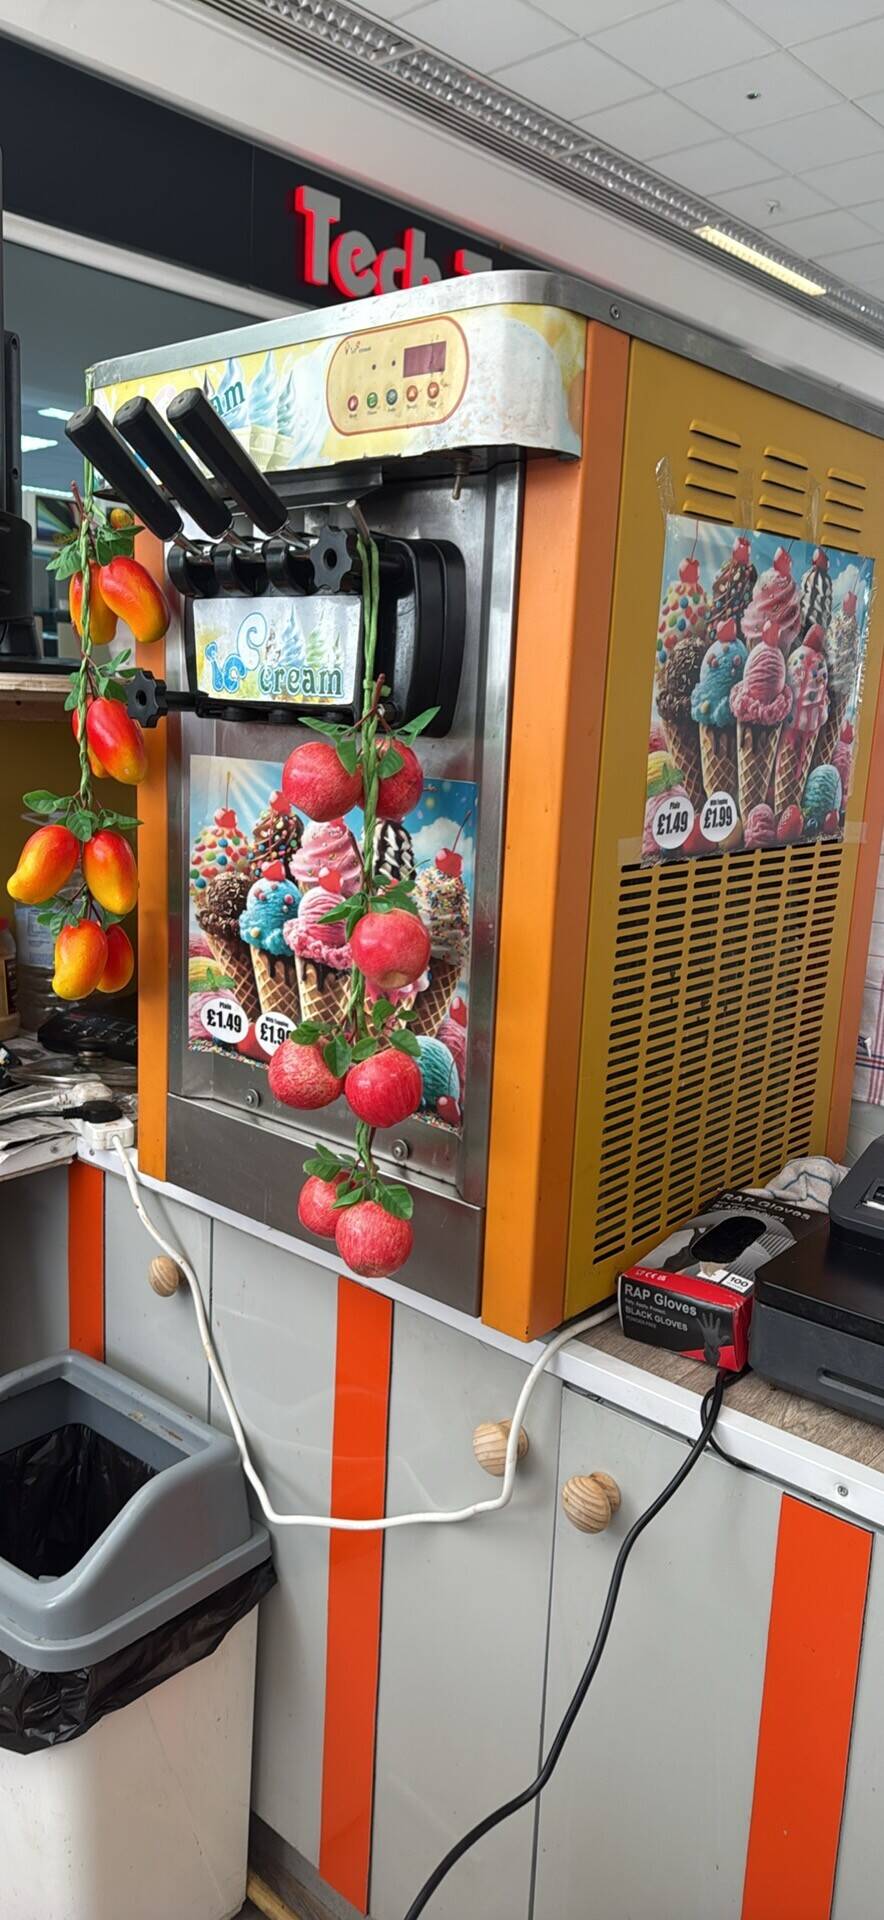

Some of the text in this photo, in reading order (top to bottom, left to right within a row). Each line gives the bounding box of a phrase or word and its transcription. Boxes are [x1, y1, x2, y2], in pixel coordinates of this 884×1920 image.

[295, 185, 442, 299] Tech
[258, 664, 345, 698] cream
[657, 811, 688, 836] £1.49
[704, 806, 733, 828] £1.99
[207, 1009, 242, 1033] £1.49
[721, 1193, 755, 1203] RAP
[758, 1200, 812, 1221] Gloves
[730, 1276, 749, 1288] 100
[624, 1283, 651, 1301] RAP
[654, 1293, 697, 1316] Gloves
[625, 1305, 653, 1321] BLACK
[654, 1315, 688, 1332] GLOVES
